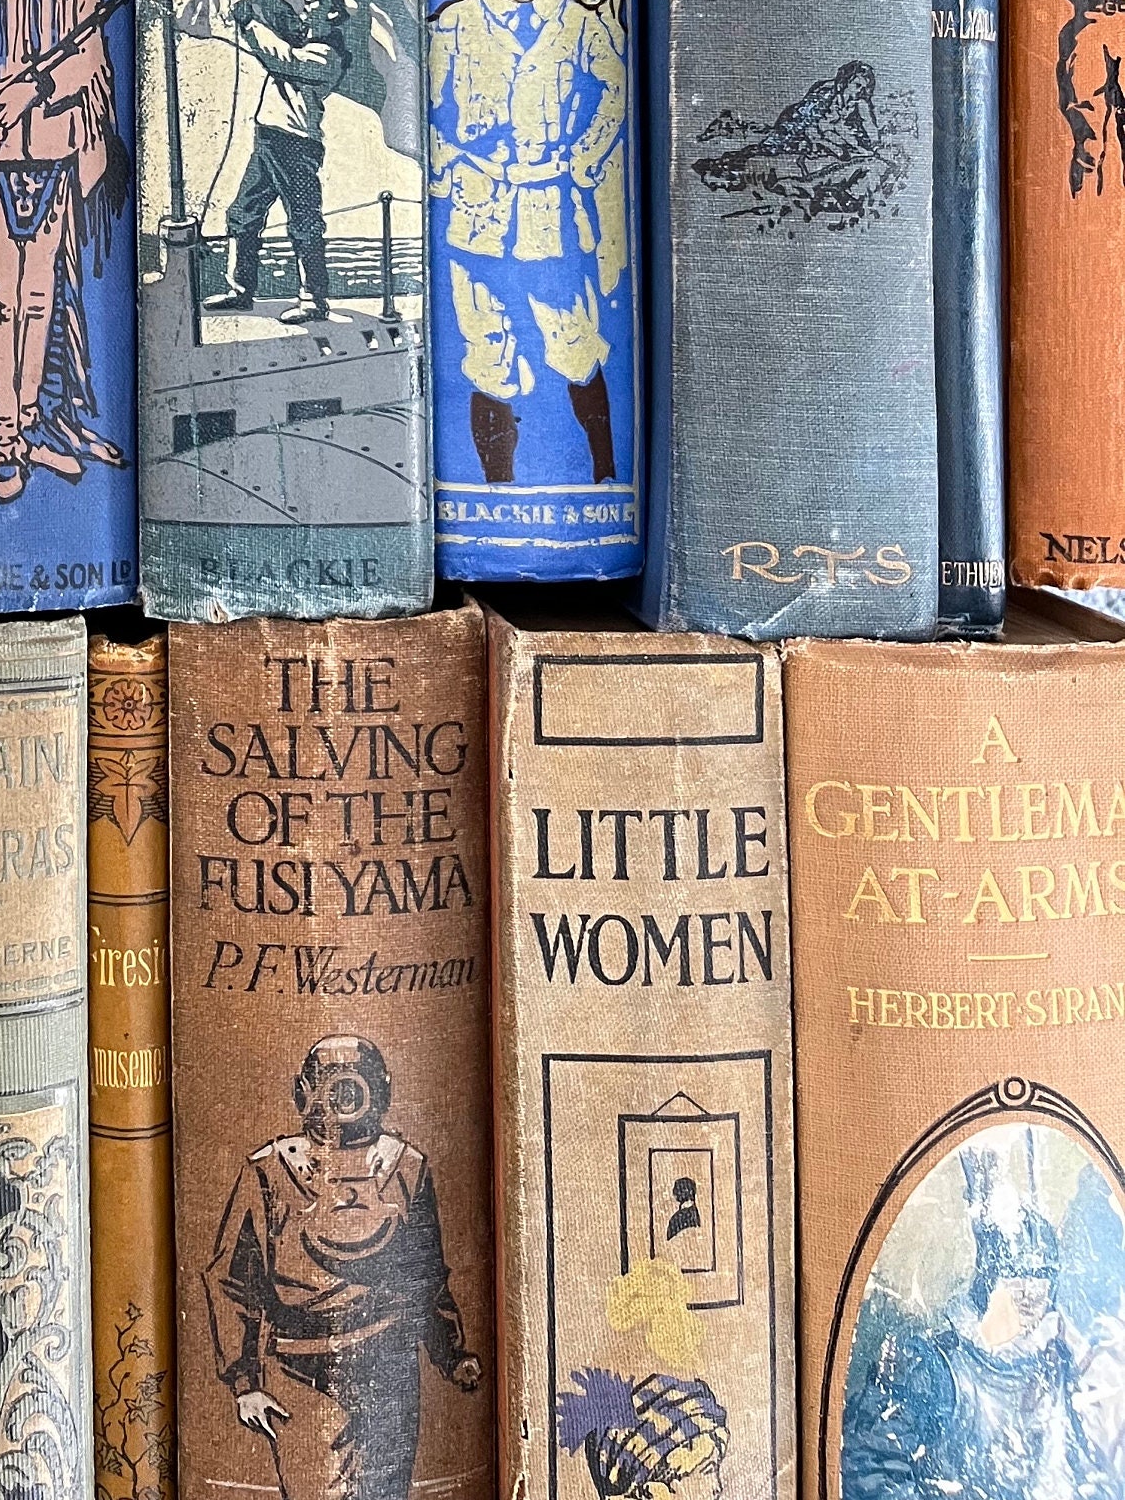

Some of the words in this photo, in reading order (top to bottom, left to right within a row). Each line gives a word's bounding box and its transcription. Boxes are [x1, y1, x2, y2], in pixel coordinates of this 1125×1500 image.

[437, 500, 556, 524] BLACKIE
[563, 504, 579, 524] &
[582, 503, 620, 523] SON
[29, 564, 50, 591] &
[54, 562, 104, 590] SON
[264, 656, 400, 713] THE
[201, 721, 469, 781] SALVING
[970, 714, 1022, 764] A
[227, 790, 312, 847] OF
[325, 787, 457, 845] THE
[532, 805, 770, 881] LITTLE
[293, 944, 474, 996] Westerman
[531, 909, 774, 987] WOMEN
[847, 986, 1017, 1030] HERBERT
